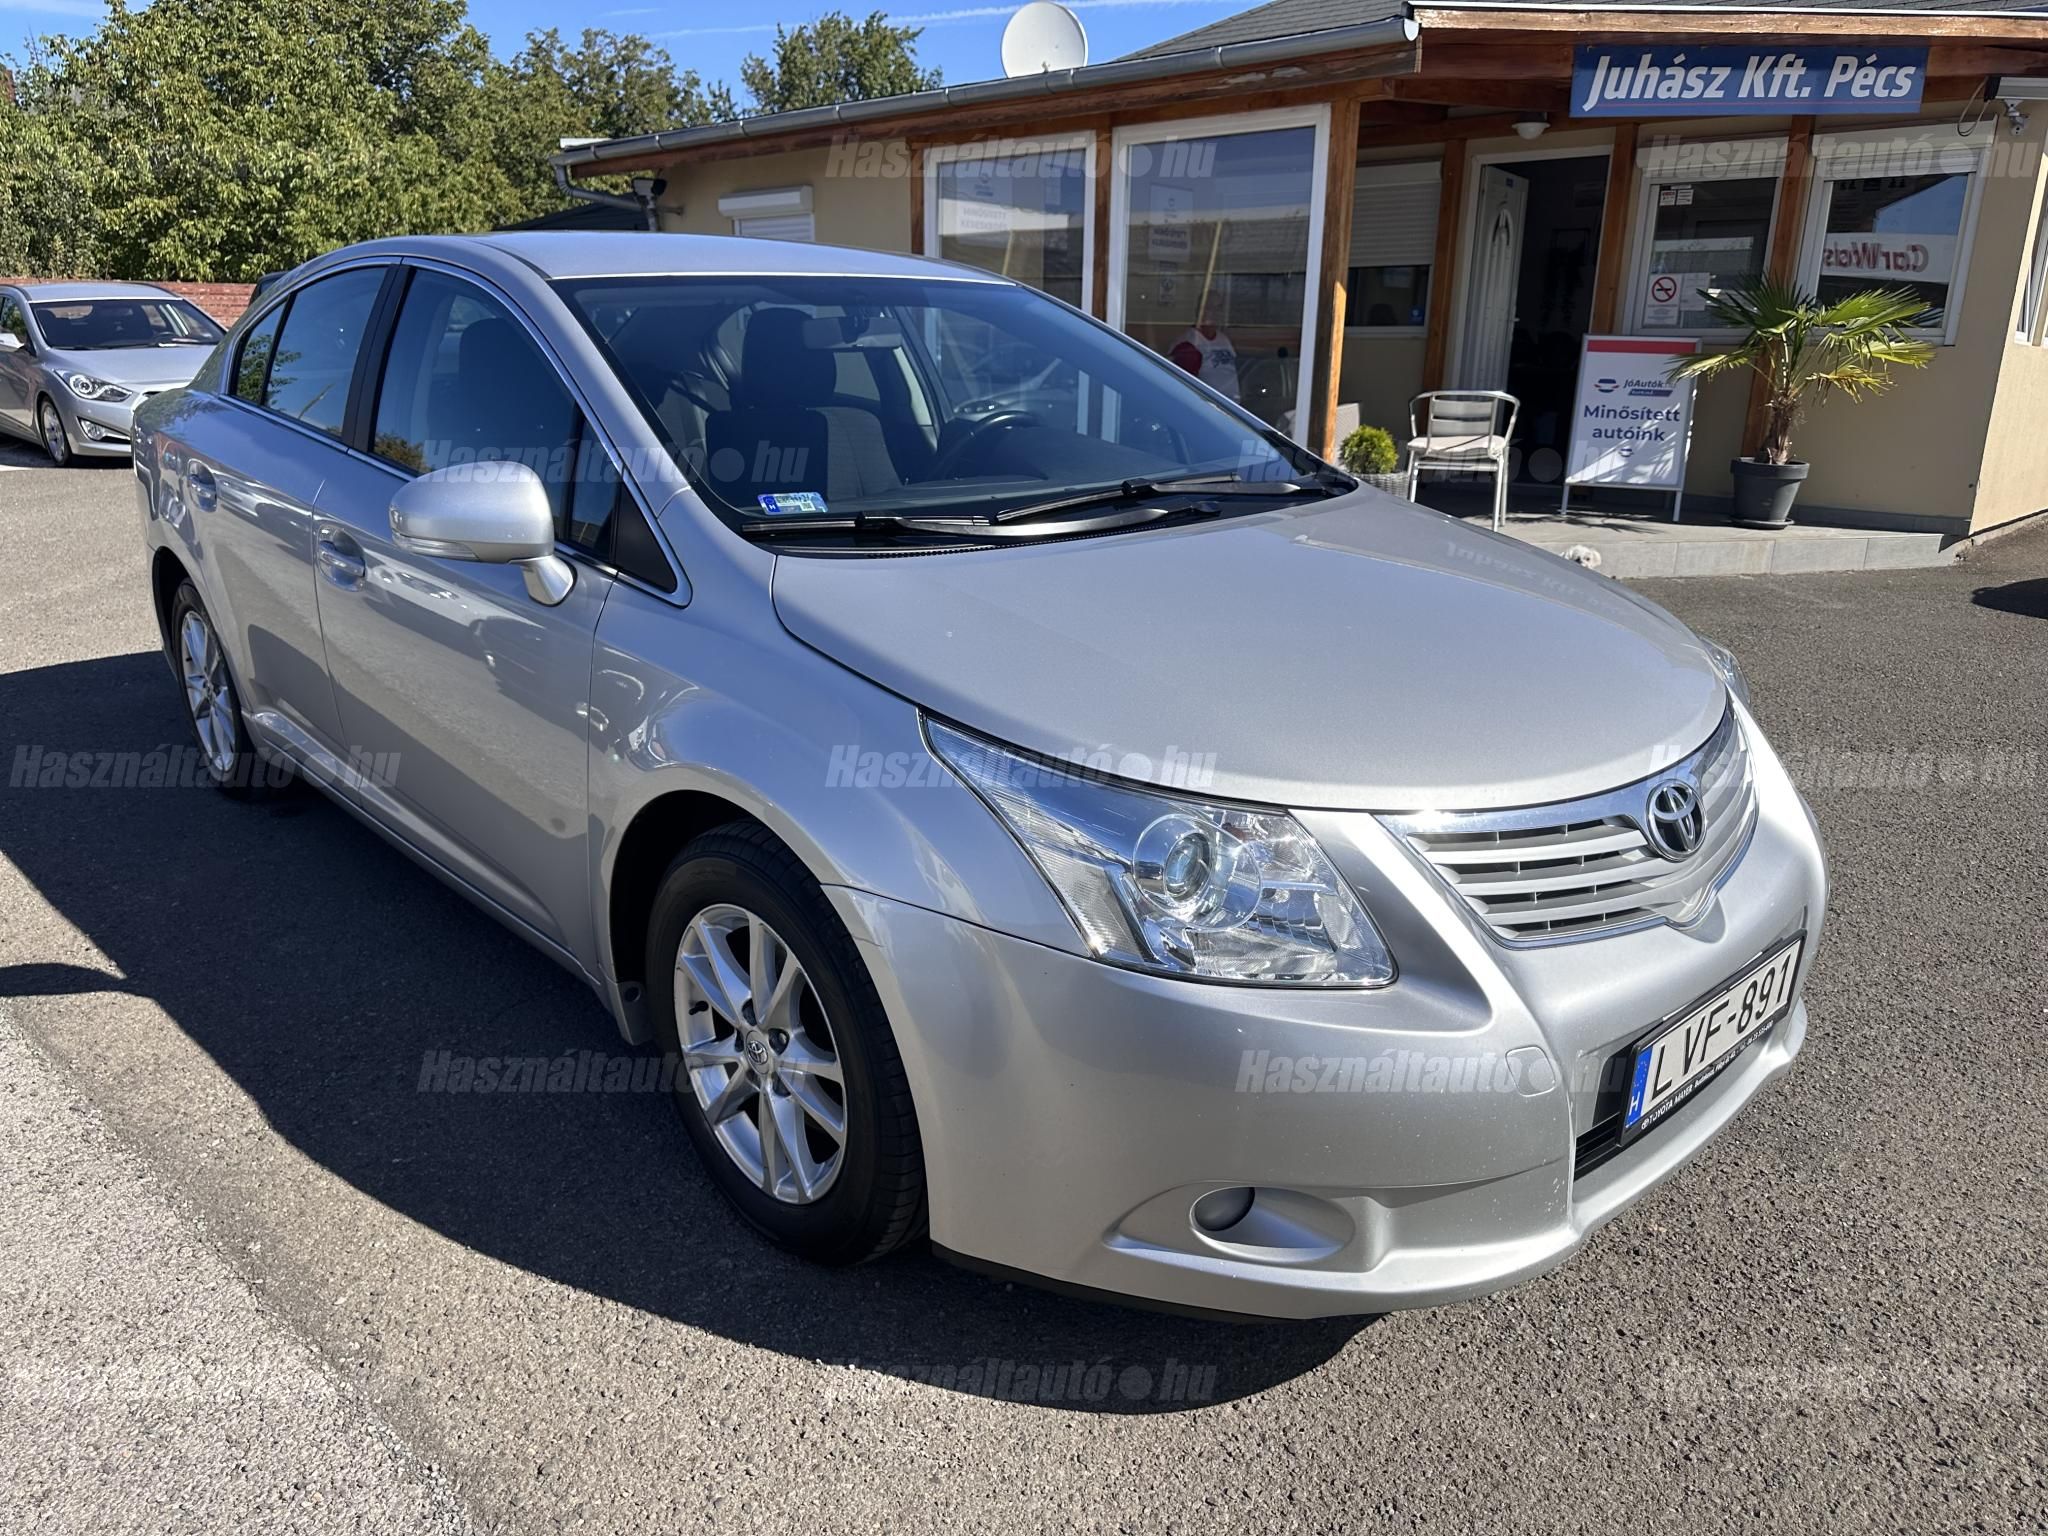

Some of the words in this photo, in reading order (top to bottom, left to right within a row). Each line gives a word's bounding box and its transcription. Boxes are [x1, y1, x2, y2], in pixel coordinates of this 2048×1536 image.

[1582, 53, 1731, 112] Juhász
[1737, 53, 1811, 98] Kft.
[1824, 53, 1917, 98] Pécs
[1584, 404, 1680, 422] Minősített
[1592, 426, 1665, 442] autóink
[1651, 953, 1792, 1101] LVF-891
[1629, 1091, 1640, 1116] H
